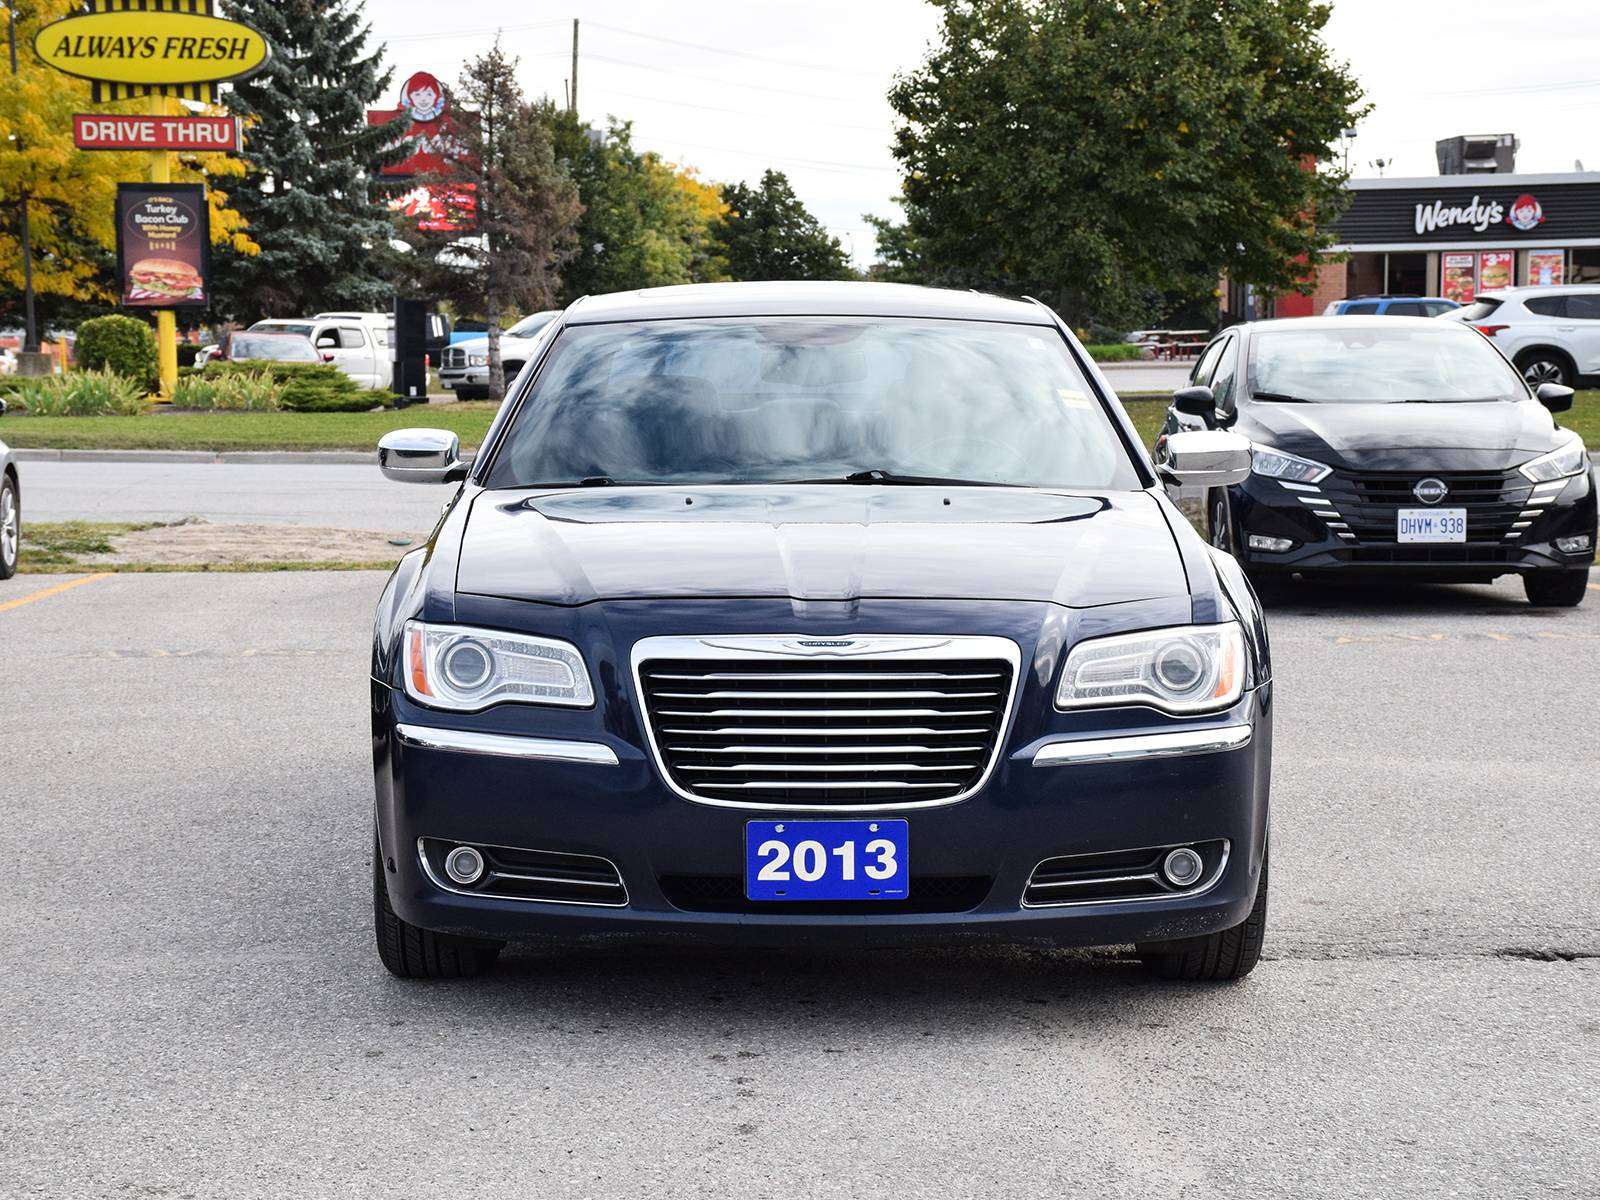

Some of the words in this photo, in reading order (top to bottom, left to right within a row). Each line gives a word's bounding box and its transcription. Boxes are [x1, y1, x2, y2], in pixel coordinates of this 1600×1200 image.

[53, 35, 157, 58] ALWAYS
[163, 37, 250, 60] FRESH
[80, 121, 155, 142] DRIVE
[162, 123, 230, 144] THRU
[134, 214, 165, 224] Bacon
[165, 214, 189, 224] Club
[145, 204, 178, 215] Turkey
[1415, 195, 1503, 235] Wendy's
[1401, 518, 1432, 534] DHVM
[1440, 518, 1464, 534] 938
[757, 839, 898, 882] 2013
